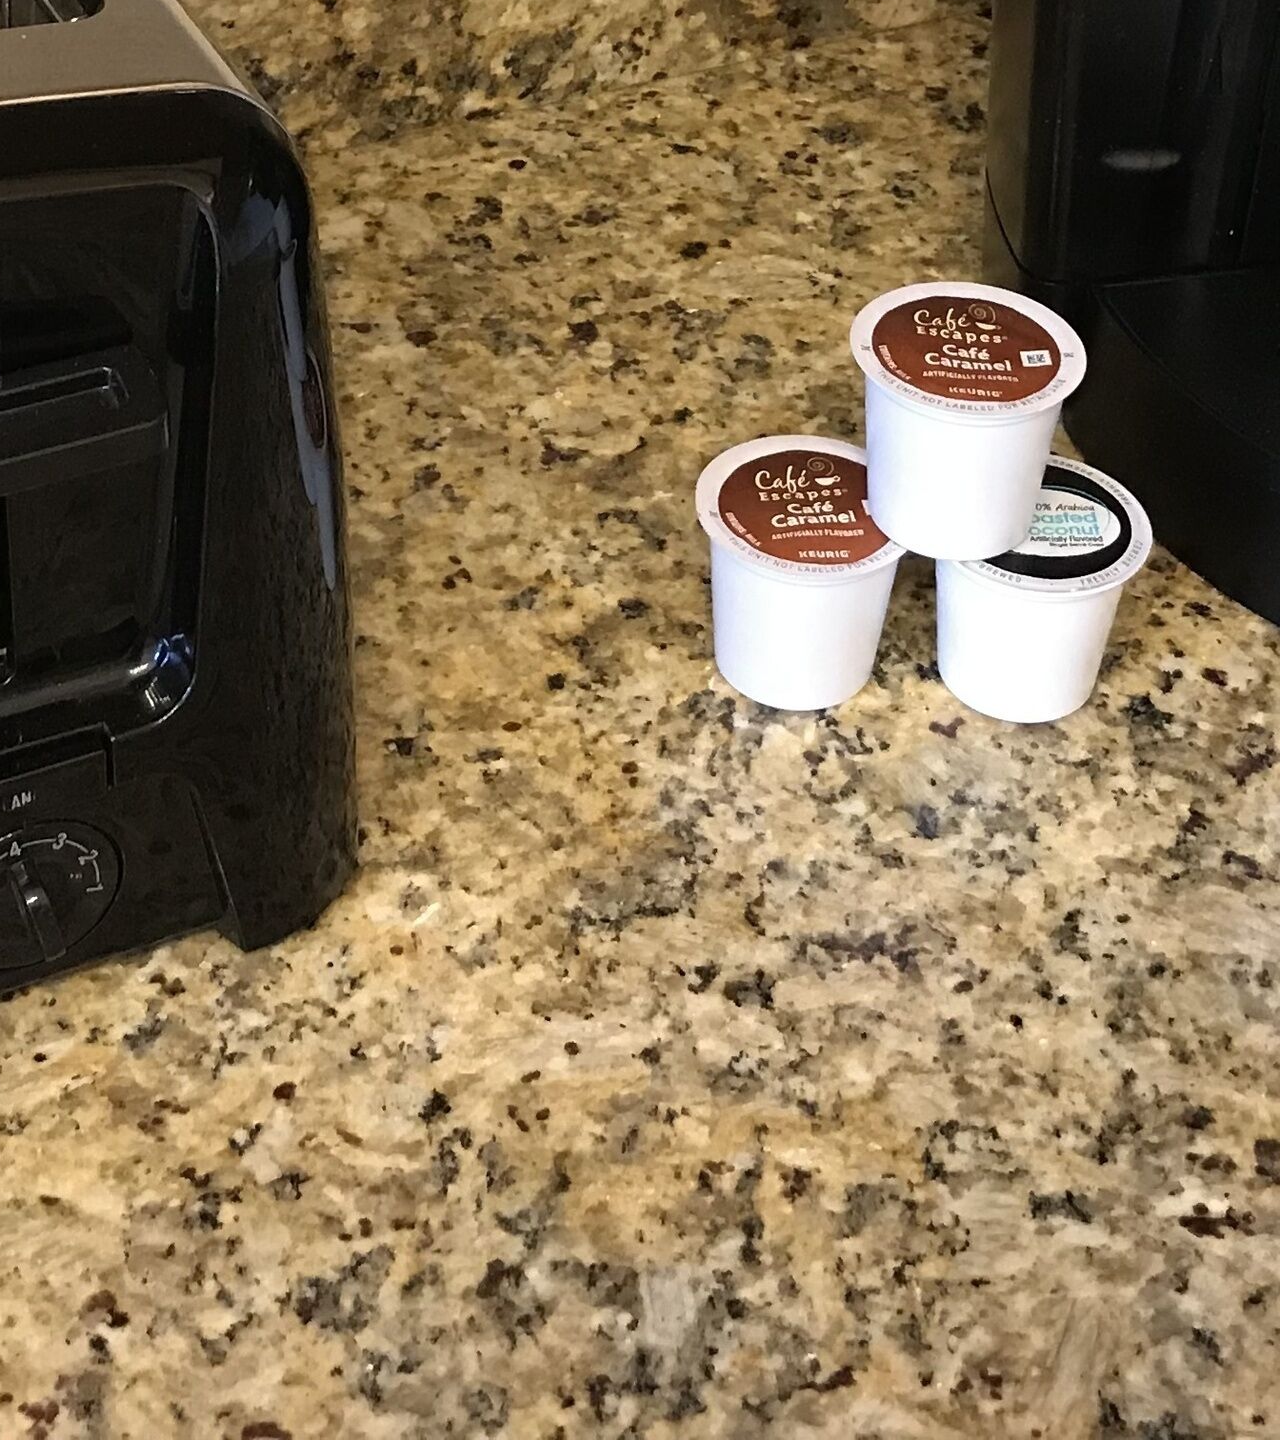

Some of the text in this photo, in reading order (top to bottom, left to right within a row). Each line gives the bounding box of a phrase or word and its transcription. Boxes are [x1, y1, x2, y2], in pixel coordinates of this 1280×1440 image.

[913, 308, 970, 331] Café
[916, 326, 1004, 344] Escapes
[942, 344, 991, 360] Café
[924, 352, 1013, 372] Caramel
[949, 386, 1003, 398] KEURIG
[755, 465, 810, 493] Café
[758, 488, 842, 502] Escapes
[787, 501, 834, 514] Café
[771, 511, 856, 528] Caramel
[1028, 524, 1099, 535] oconut
[798, 550, 850, 559] KEURIG
[10, 841, 21, 856] 4
[52, 832, 67, 850] 3
